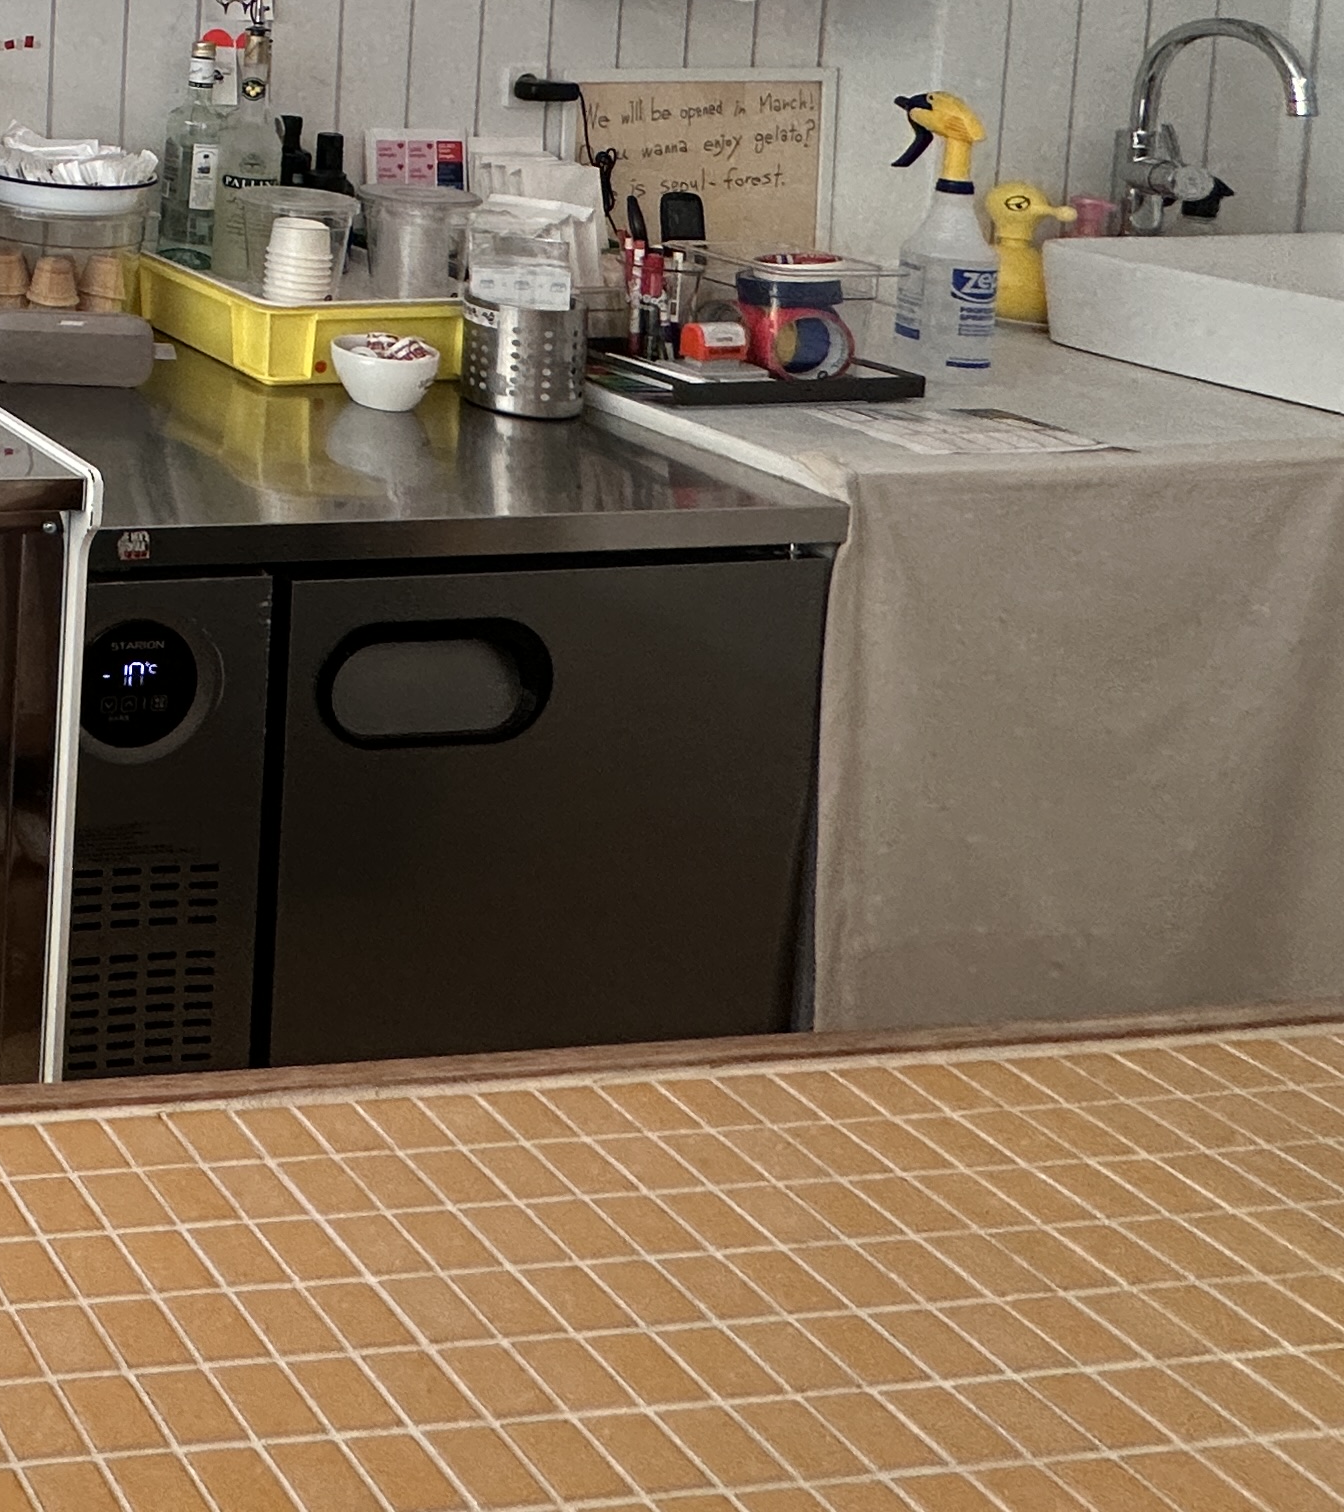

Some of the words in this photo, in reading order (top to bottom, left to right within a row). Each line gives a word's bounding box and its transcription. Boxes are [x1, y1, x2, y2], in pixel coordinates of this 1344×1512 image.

[621, 100, 644, 126] will
[651, 97, 673, 122] be
[679, 100, 724, 126] opened
[733, 100, 747, 116] in
[758, 90, 815, 115] March!
[642, 140, 689, 159] wanna
[703, 134, 744, 160] enjoy
[754, 118, 816, 153] gelato?
[225, 175, 280, 188] PALLIN
[630, 178, 647, 198] is
[111, 640, 166, 651] STARION
